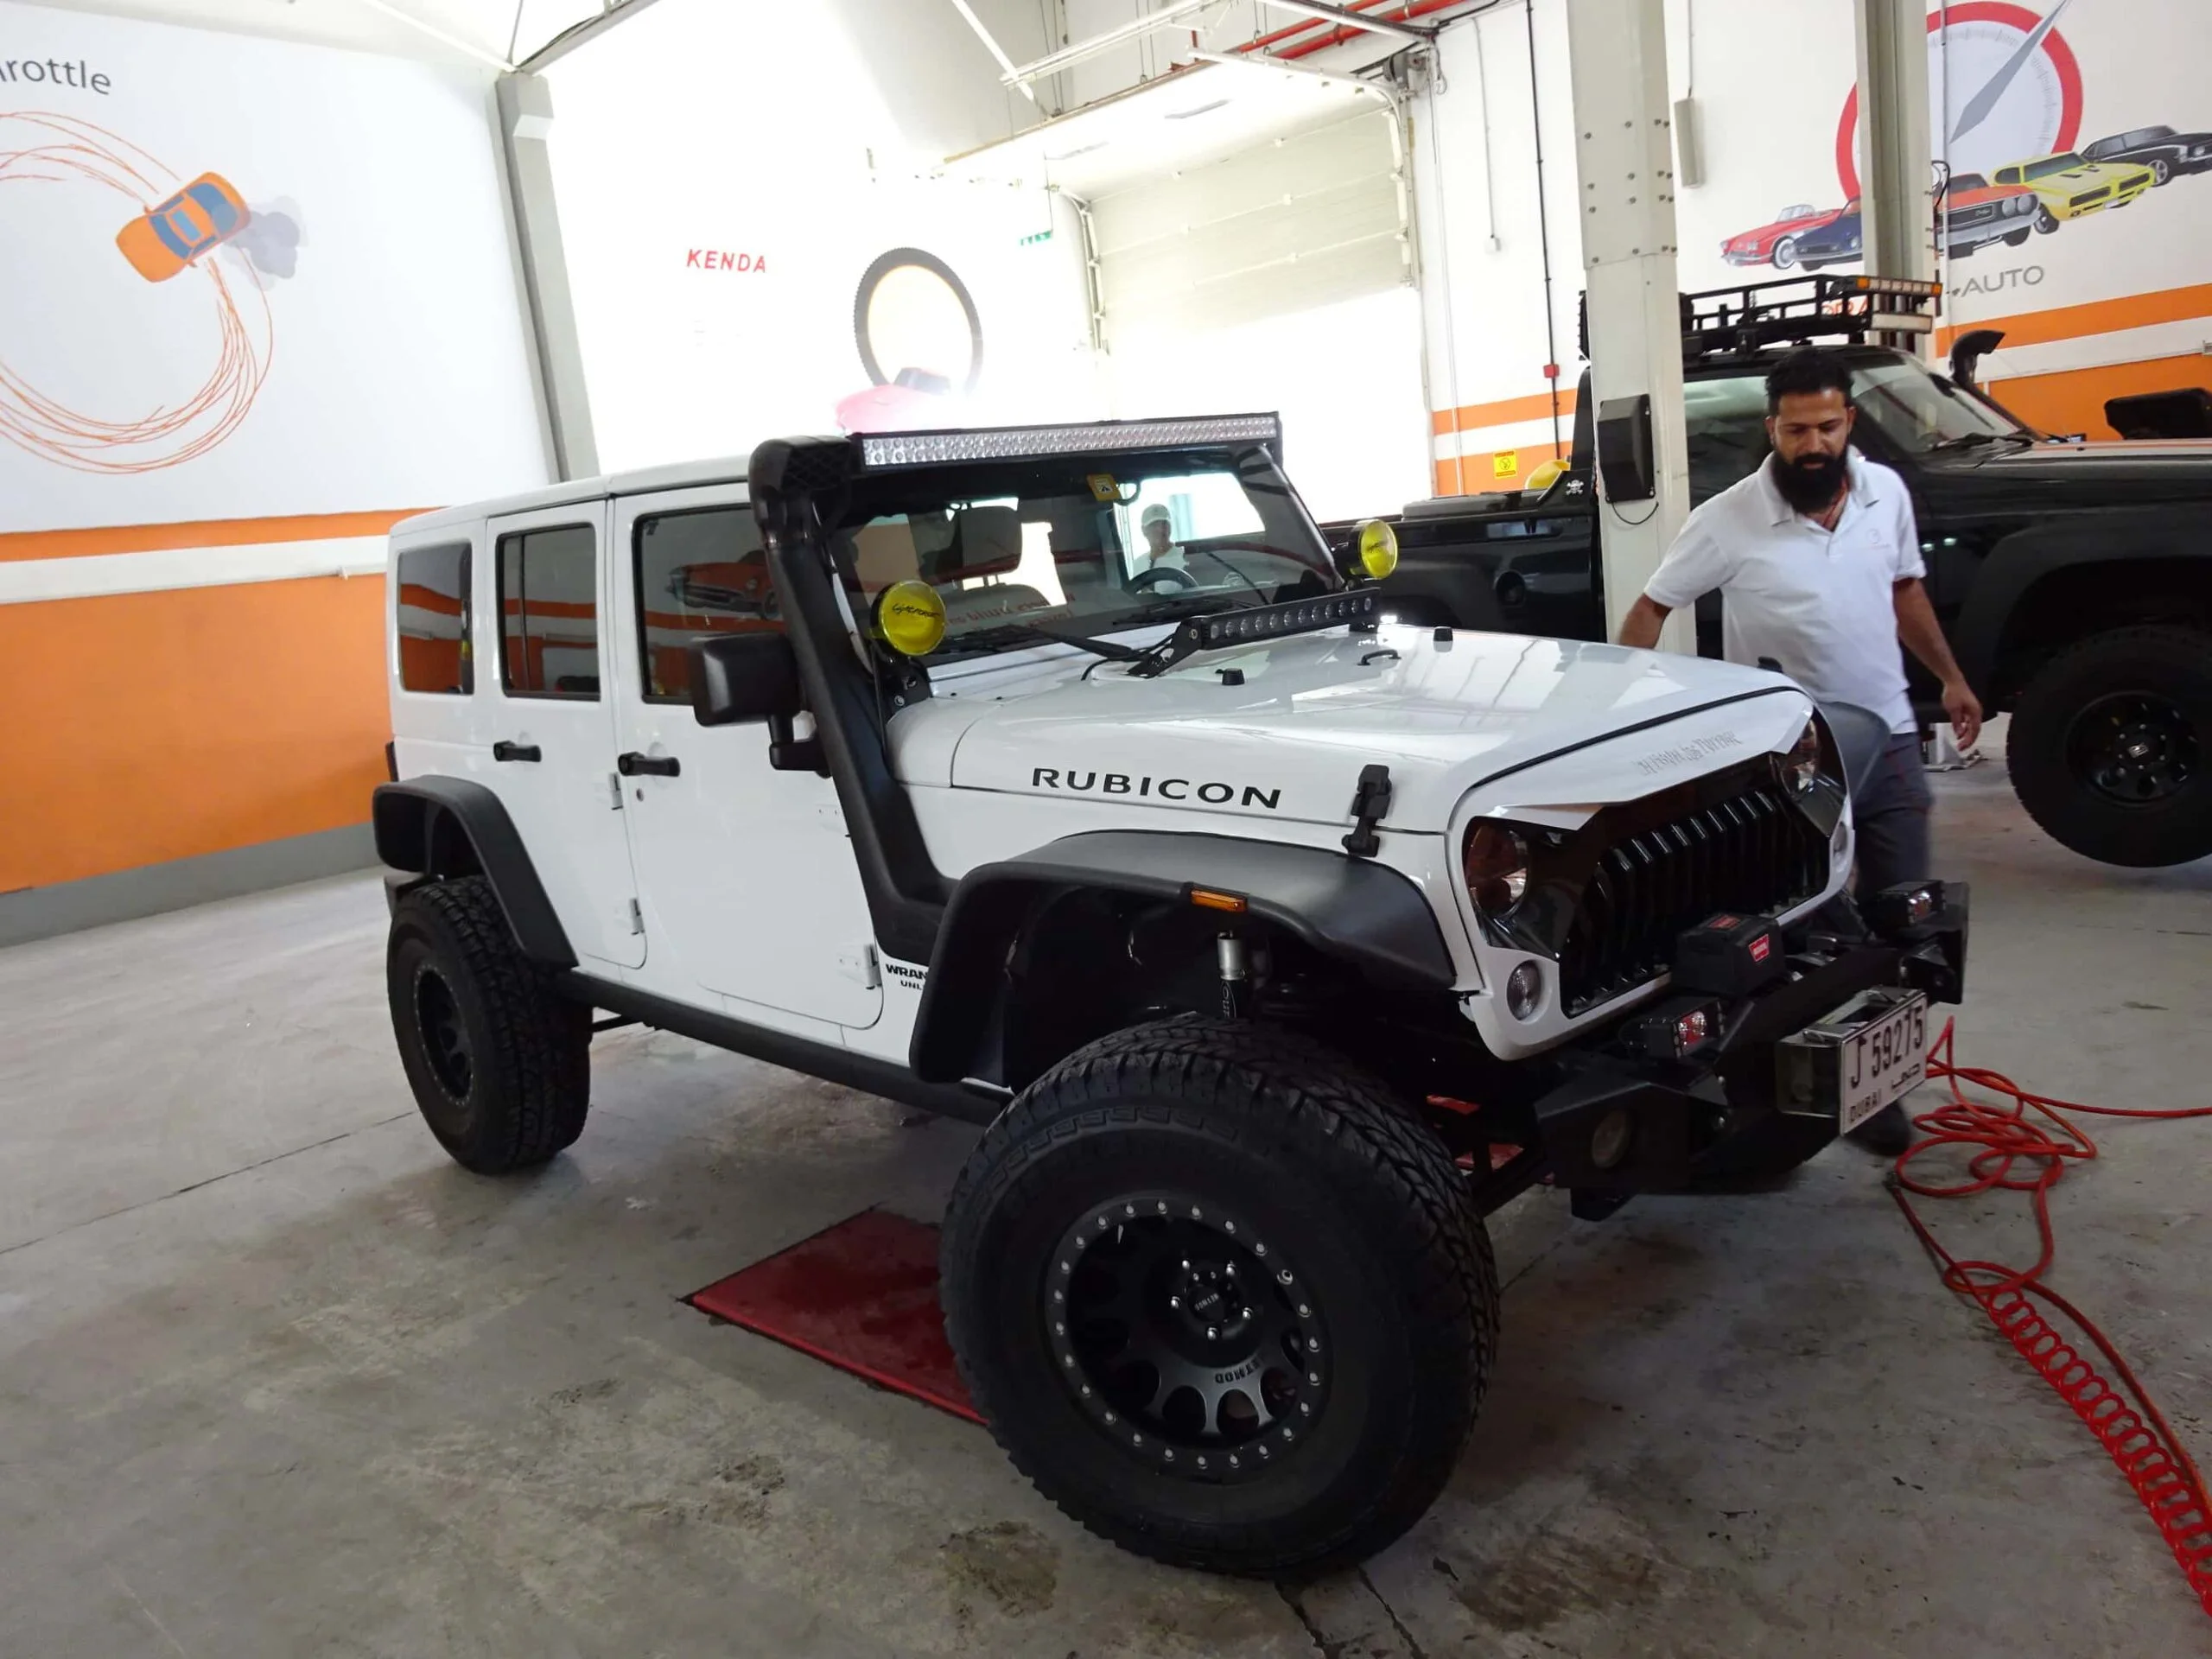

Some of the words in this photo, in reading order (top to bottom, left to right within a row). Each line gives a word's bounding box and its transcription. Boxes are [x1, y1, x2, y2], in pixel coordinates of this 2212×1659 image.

[686, 248, 766, 273] KENDA
[1960, 264, 2044, 298] AUTO
[1032, 767, 1282, 810] RUBICON
[1850, 1036, 1867, 1090] J
[1871, 1005, 1923, 1078] 59275
